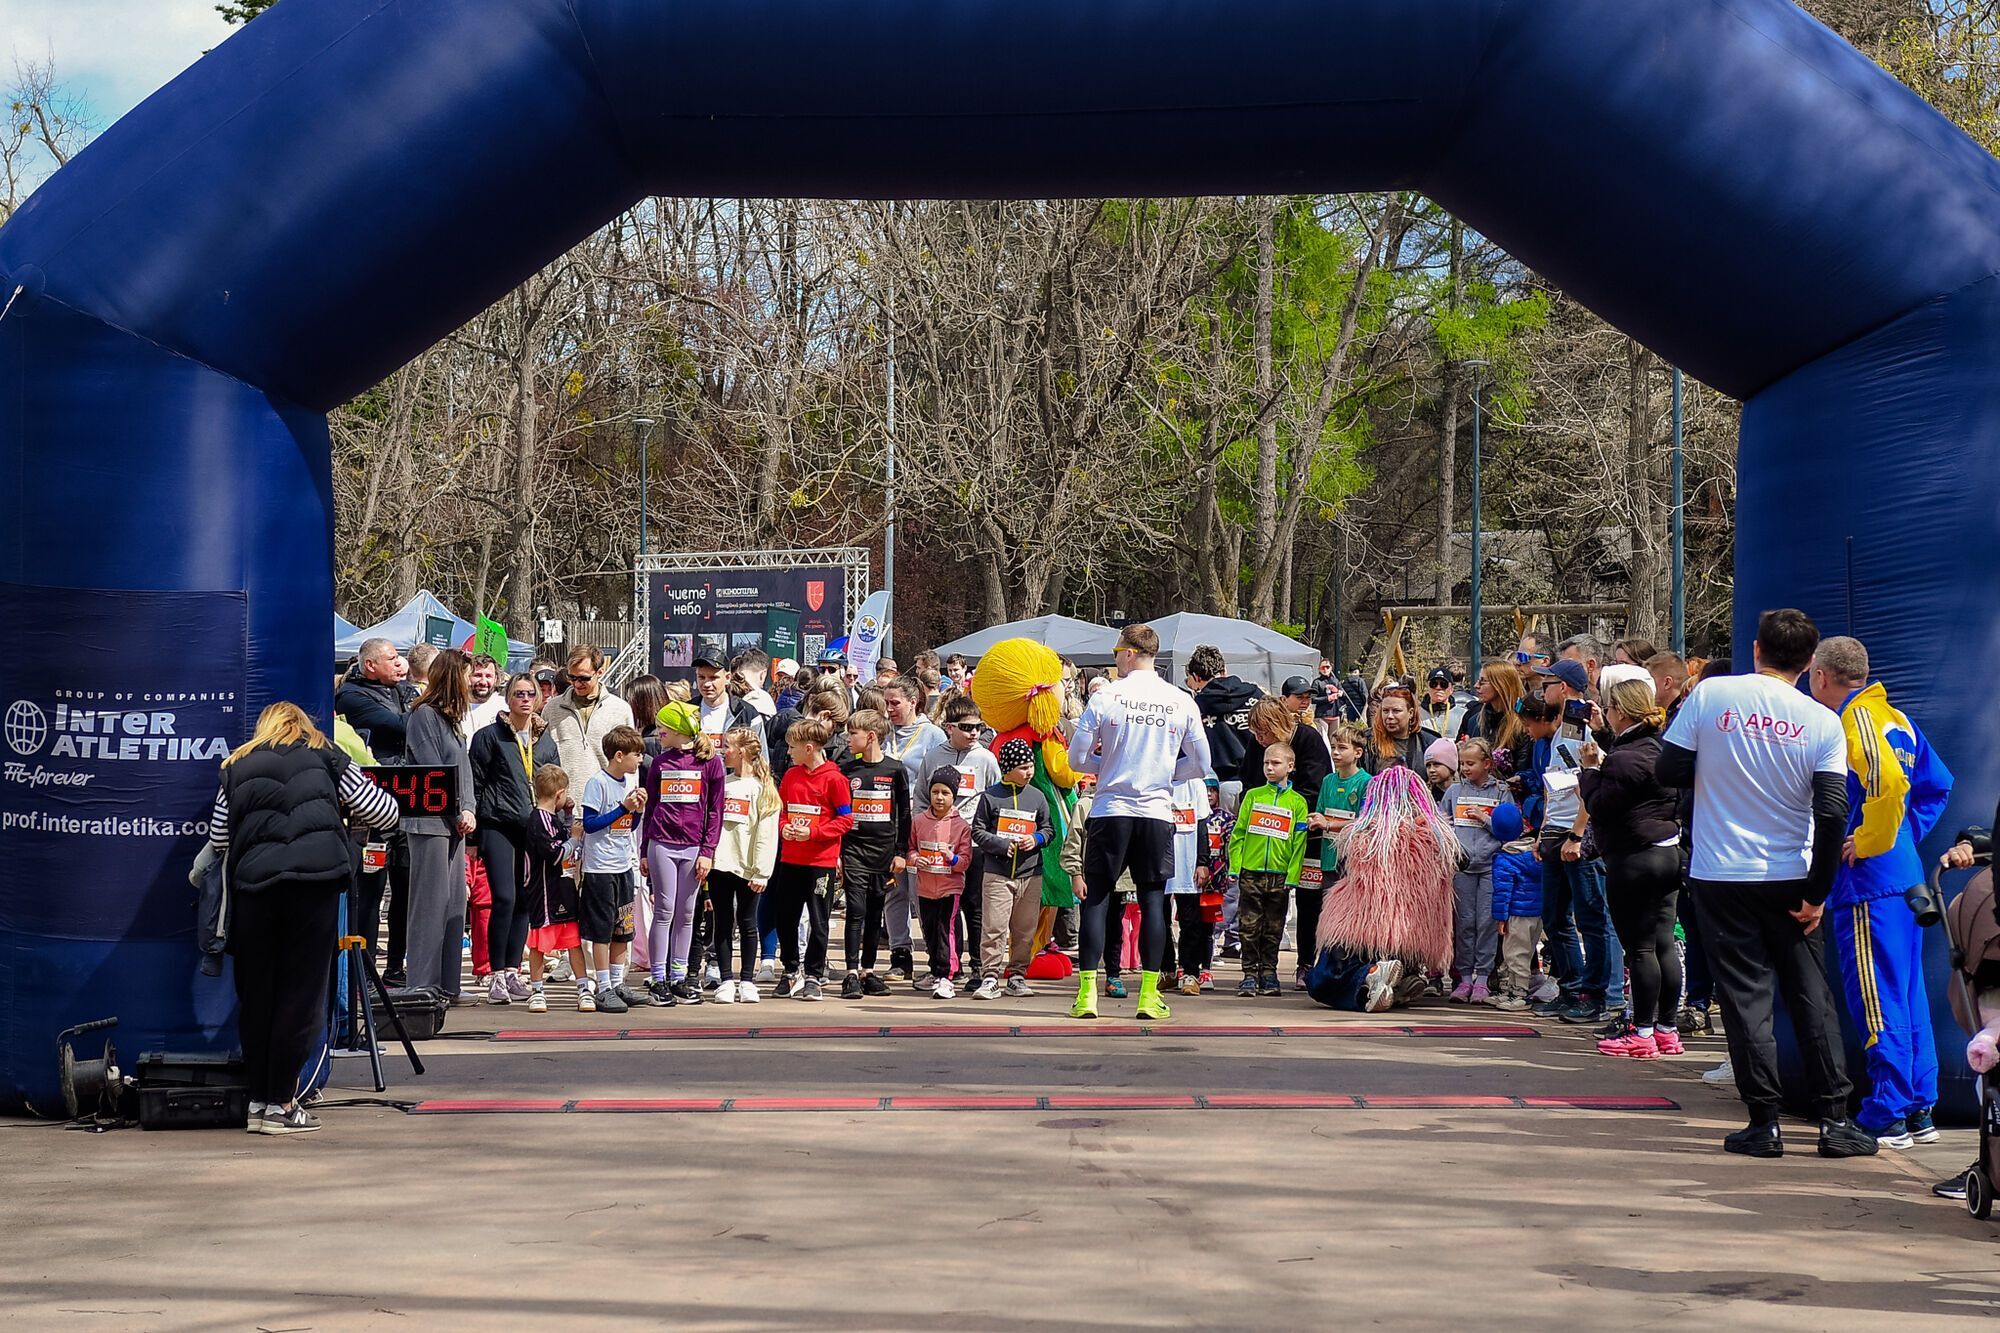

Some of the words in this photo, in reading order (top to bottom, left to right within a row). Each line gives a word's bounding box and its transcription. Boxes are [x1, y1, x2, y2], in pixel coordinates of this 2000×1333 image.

[673, 601, 702, 615] небо
[55, 689, 105, 700] GROUP
[115, 692, 134, 701] OF
[143, 692, 235, 702] COMPANIES
[1120, 698, 1174, 714] чисте
[1125, 713, 1166, 728] небо
[1745, 713, 1805, 738] АРОУ
[50, 734, 231, 761] ATLETIKA
[667, 783, 693, 793] 4000
[858, 803, 884, 813] 4009
[2, 811, 209, 836] prof.interatletika.co
[1008, 823, 1026, 833] 4011
[1258, 817, 1282, 829] 4010
[1301, 870, 1323, 881] 2067
